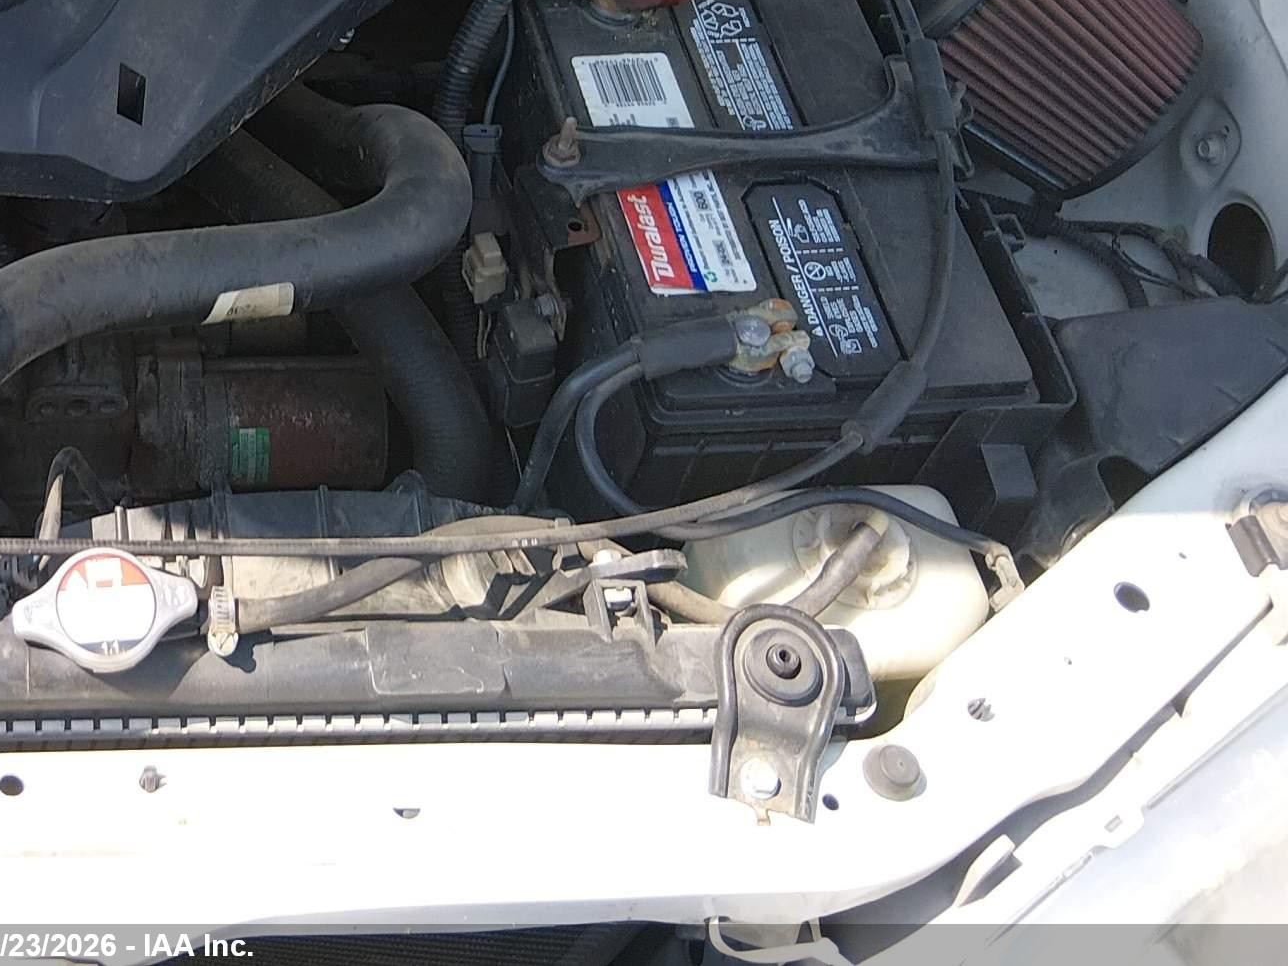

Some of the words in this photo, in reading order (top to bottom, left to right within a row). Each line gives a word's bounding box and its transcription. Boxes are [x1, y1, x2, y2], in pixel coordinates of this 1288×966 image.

[693, 191, 709, 210] 600
[627, 192, 675, 282] Duralast
[768, 219, 795, 263] POISON
[791, 274, 820, 324] DANGER
